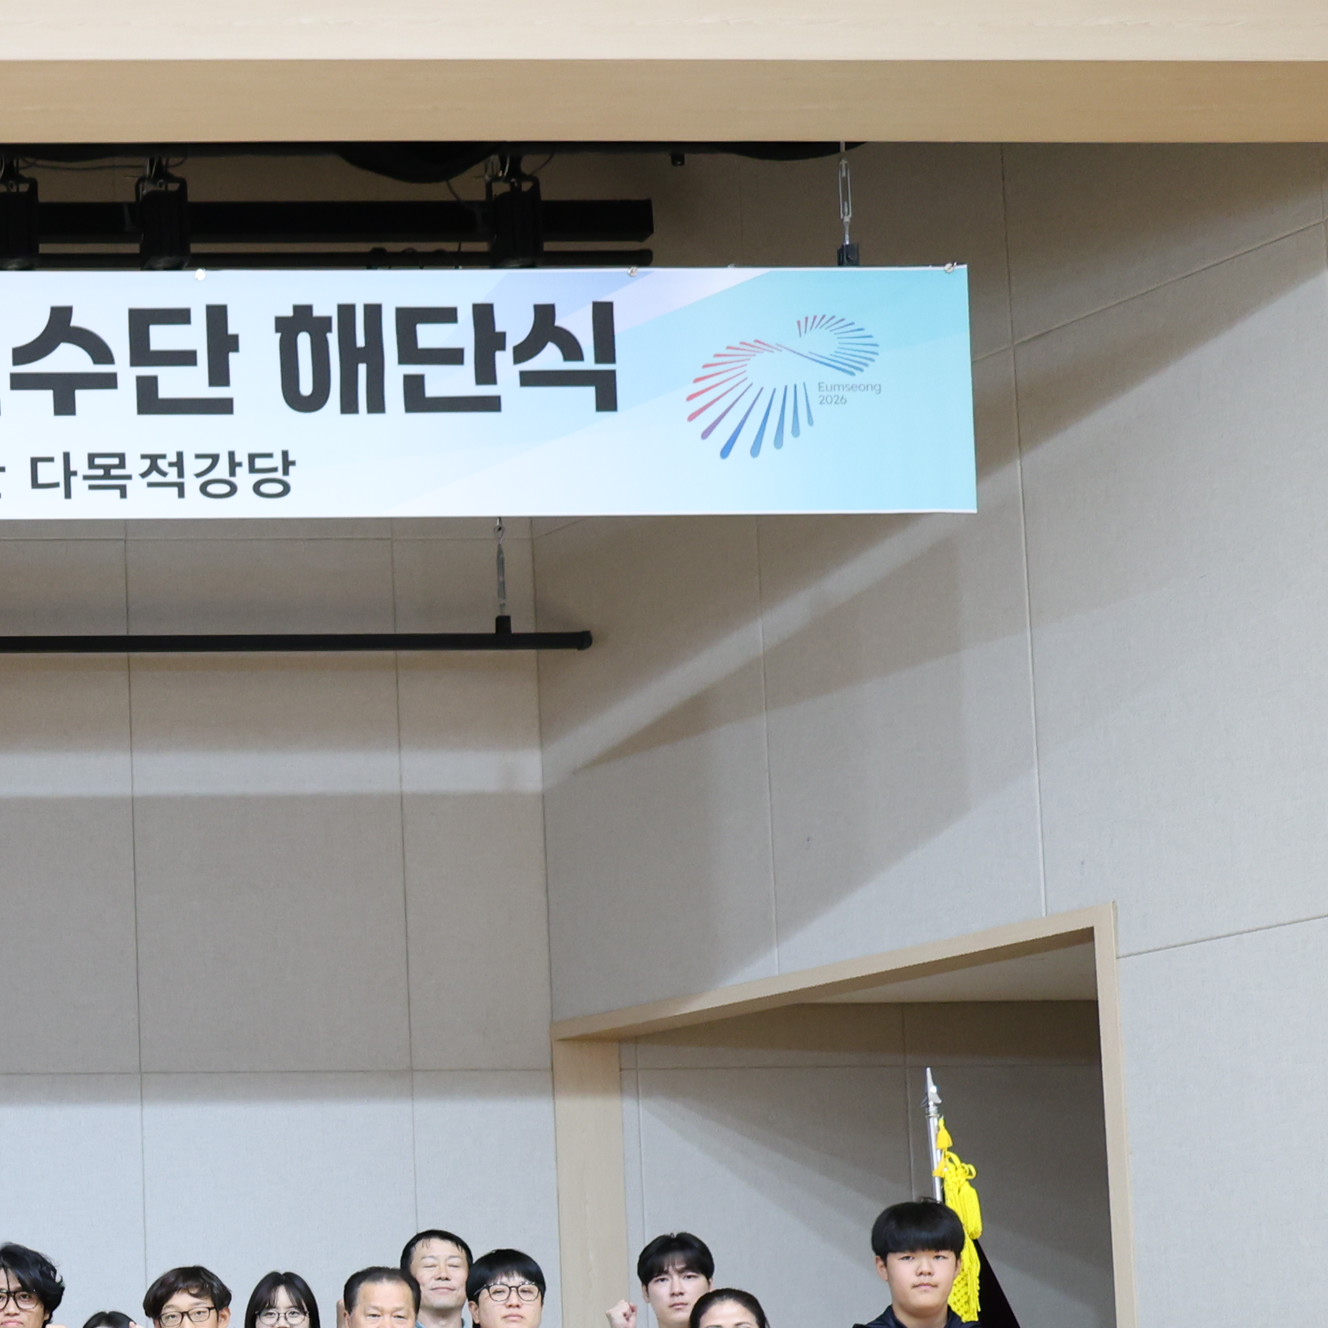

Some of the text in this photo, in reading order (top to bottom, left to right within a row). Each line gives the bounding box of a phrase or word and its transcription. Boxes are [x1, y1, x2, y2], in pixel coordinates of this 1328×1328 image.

[274, 300, 619, 415] 해단식
[818, 382, 882, 395] Eumseong
[818, 394, 847, 405] 2026
[30, 449, 297, 500] 다목적강당
